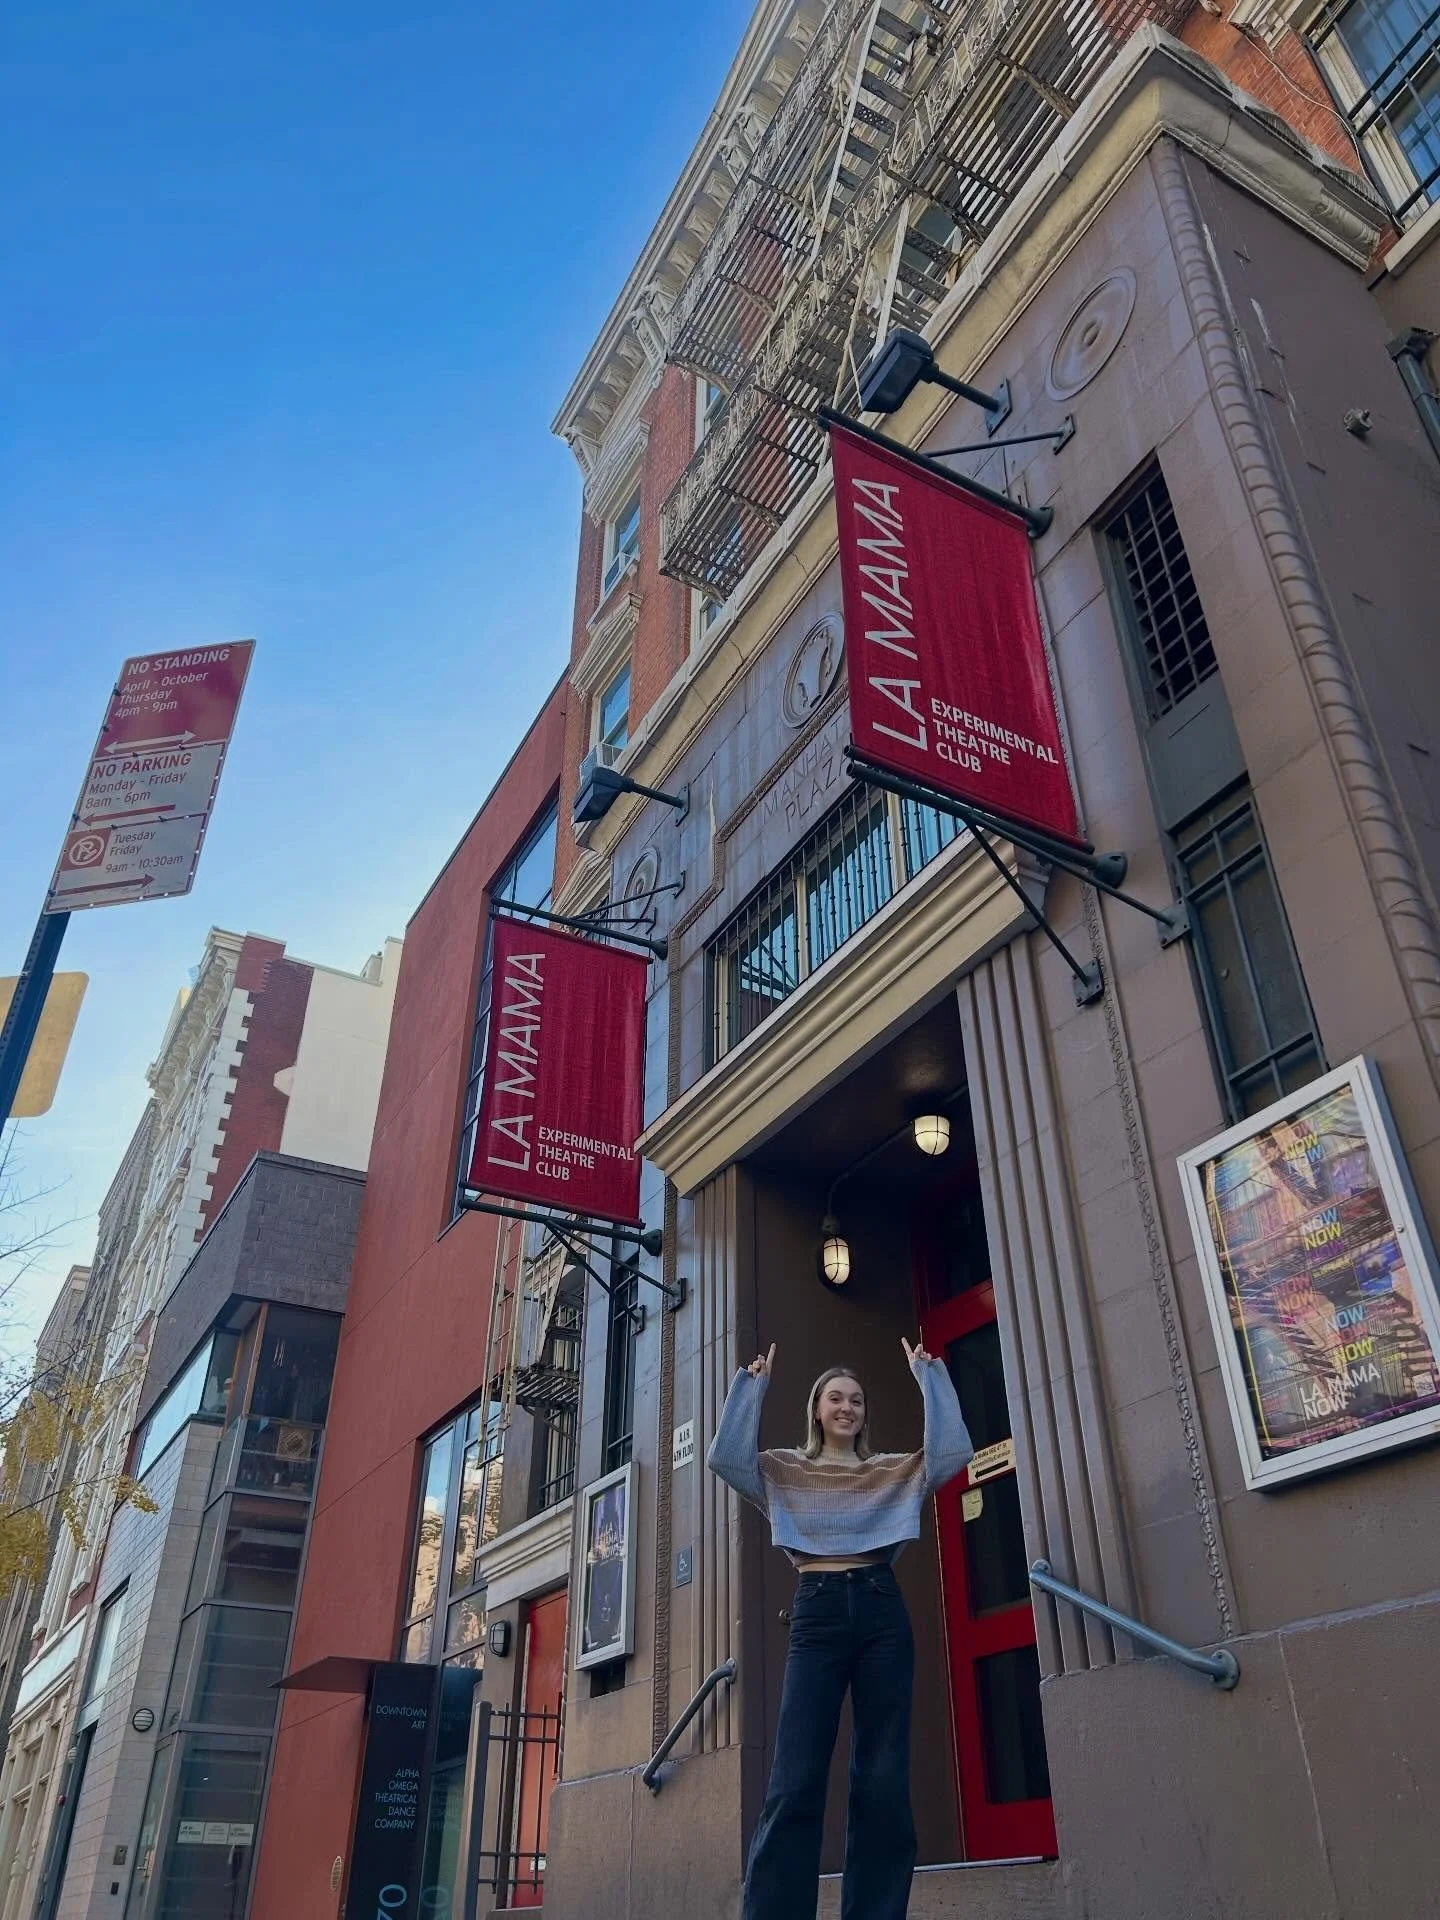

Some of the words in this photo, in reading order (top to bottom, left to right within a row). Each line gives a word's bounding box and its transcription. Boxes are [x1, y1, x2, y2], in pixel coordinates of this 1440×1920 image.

[851, 478, 918, 661] MAMA
[128, 660, 150, 676] NO
[153, 648, 230, 672] STANDING
[122, 678, 150, 694] April
[161, 671, 209, 686] October
[114, 705, 141, 719] 4pm
[151, 700, 178, 714] 9pm
[119, 689, 172, 705] Thursday
[868, 676, 928, 752] LA
[930, 698, 1059, 765] EXPERIMENTAL
[933, 718, 1010, 765] THEATRE
[93, 762, 117, 779] NO
[121, 752, 192, 775] PARKING
[763, 707, 850, 825] MANHAT
[935, 743, 982, 774] CLUB
[89, 778, 136, 795] Monday
[148, 771, 187, 786] Friday
[85, 796, 112, 809] 8am
[124, 790, 151, 804] 6pm
[109, 844, 143, 857] Friday
[114, 830, 156, 845] Tuesday
[105, 862, 128, 874] 9am
[138, 855, 183, 870] 10:30am
[494, 953, 546, 1099] MAMA
[487, 1114, 533, 1172] LA
[537, 1143, 595, 1170] THEATRE
[538, 1126, 635, 1161] EXPERIMENTAL
[535, 1161, 570, 1181] CLUB
[1301, 1207, 1338, 1237] NOW
[1304, 1221, 1341, 1251] NOW
[1326, 1304, 1363, 1335] NOW
[1333, 1337, 1374, 1368] NOW
[1300, 1382, 1323, 1403] LA
[1326, 1362, 1381, 1397] MAMA
[1303, 1393, 1348, 1420] NOW
[682, 1442, 693, 1459] FLOO
[375, 1705, 427, 1717] DOWNTOWN
[411, 1720, 426, 1729] ART
[388, 1780, 418, 1791] OMEGA
[396, 1768, 420, 1778] ALPHA
[375, 1792, 417, 1804] THEATRICAL
[374, 1818, 415, 1829] COMPANY
[388, 1807, 416, 1817] DANCE
